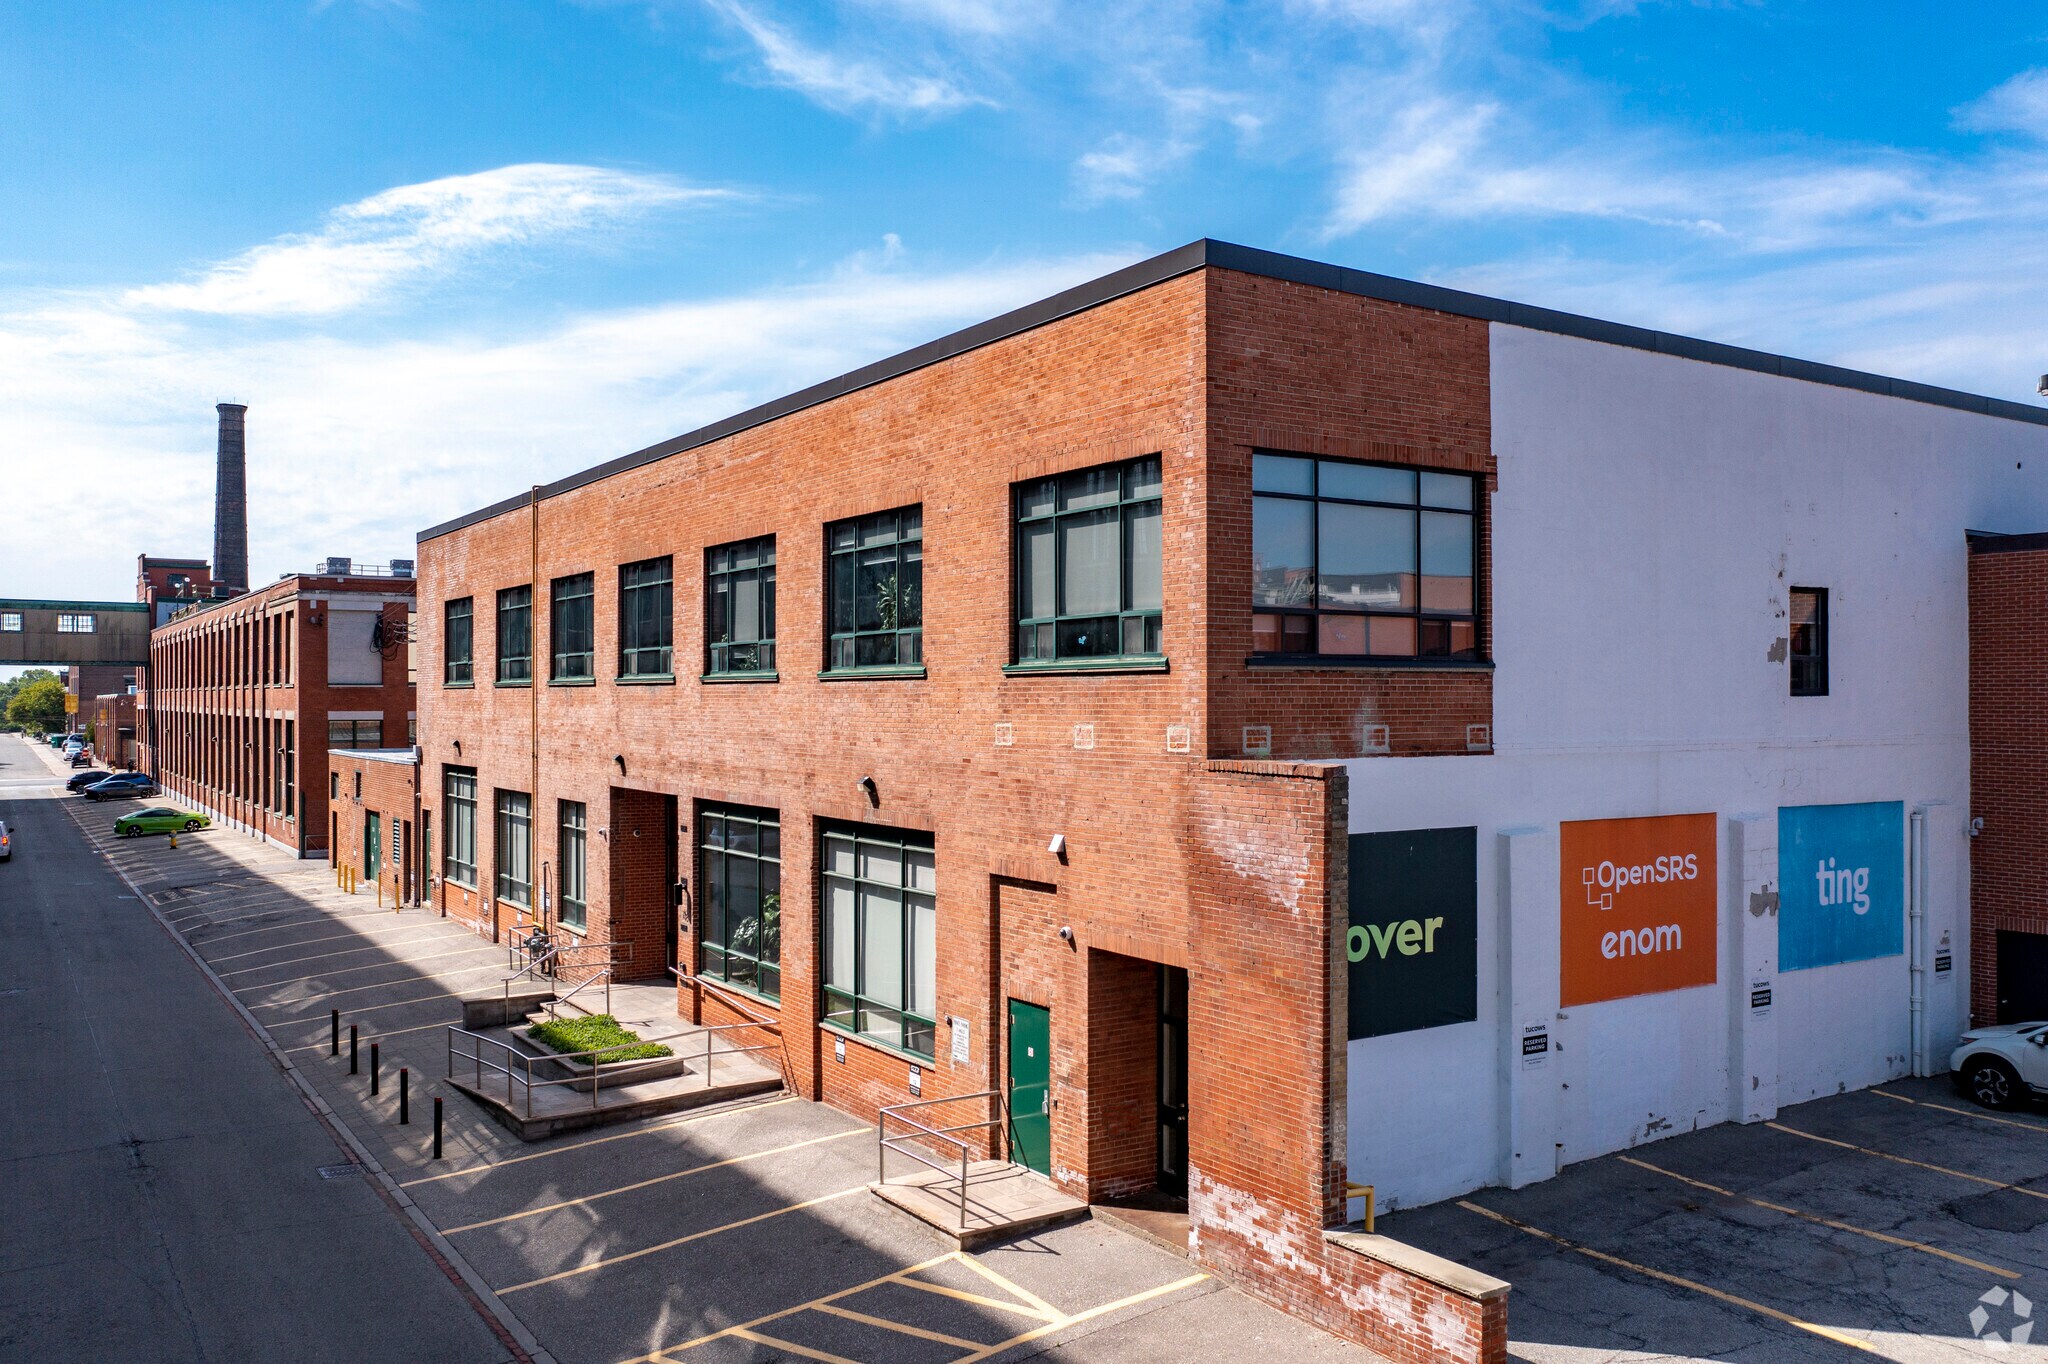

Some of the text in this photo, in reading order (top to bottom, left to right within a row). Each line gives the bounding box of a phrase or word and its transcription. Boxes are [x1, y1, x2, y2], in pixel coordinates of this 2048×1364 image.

[1598, 854, 1698, 893] OpenSRS
[1816, 857, 1870, 915] ting
[1601, 924, 1682, 959] enom
[1752, 992, 1771, 1000] RESERVED
[1525, 1024, 1546, 1033] tucows
[1524, 1037, 1547, 1046] RESERVED
[1525, 1044, 1546, 1052] PARKING
